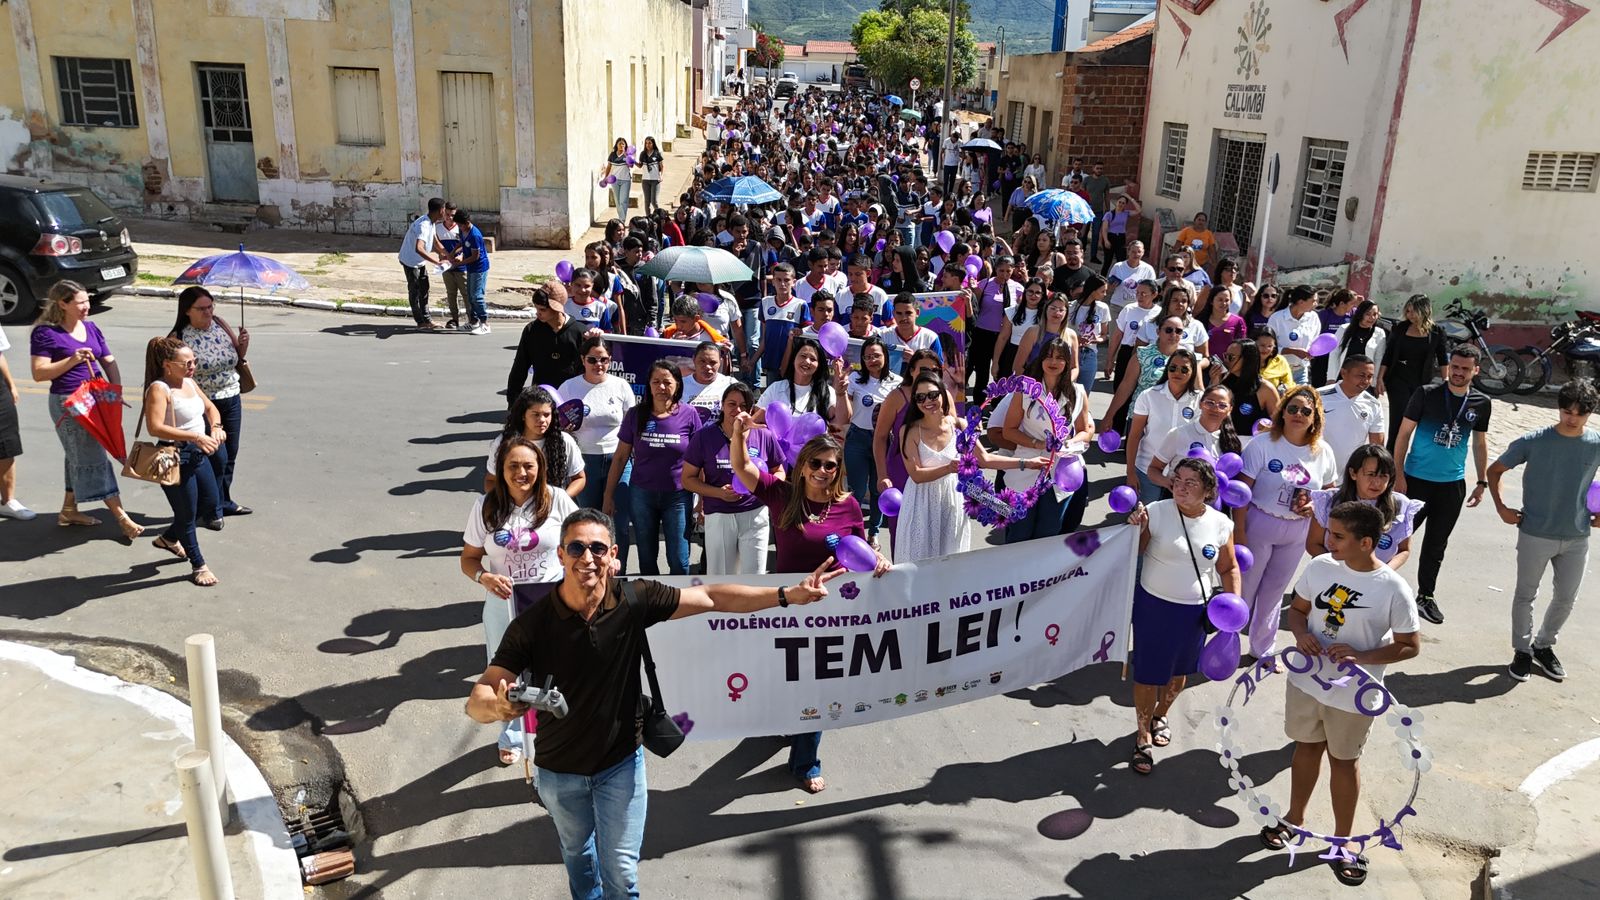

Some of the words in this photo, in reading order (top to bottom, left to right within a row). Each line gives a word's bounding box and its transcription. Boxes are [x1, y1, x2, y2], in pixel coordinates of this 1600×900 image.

[1225, 92, 1265, 113] CALUMBI
[504, 550, 549, 565] Agosto
[708, 614, 799, 631] VIOLÊNCIA
[804, 614, 872, 628] CONTRA
[877, 602, 941, 623] MULHER
[949, 592, 982, 610] NÃO
[986, 585, 1015, 602] TEM
[1019, 566, 1088, 595] DESCULPA.
[774, 628, 902, 682] TEM
